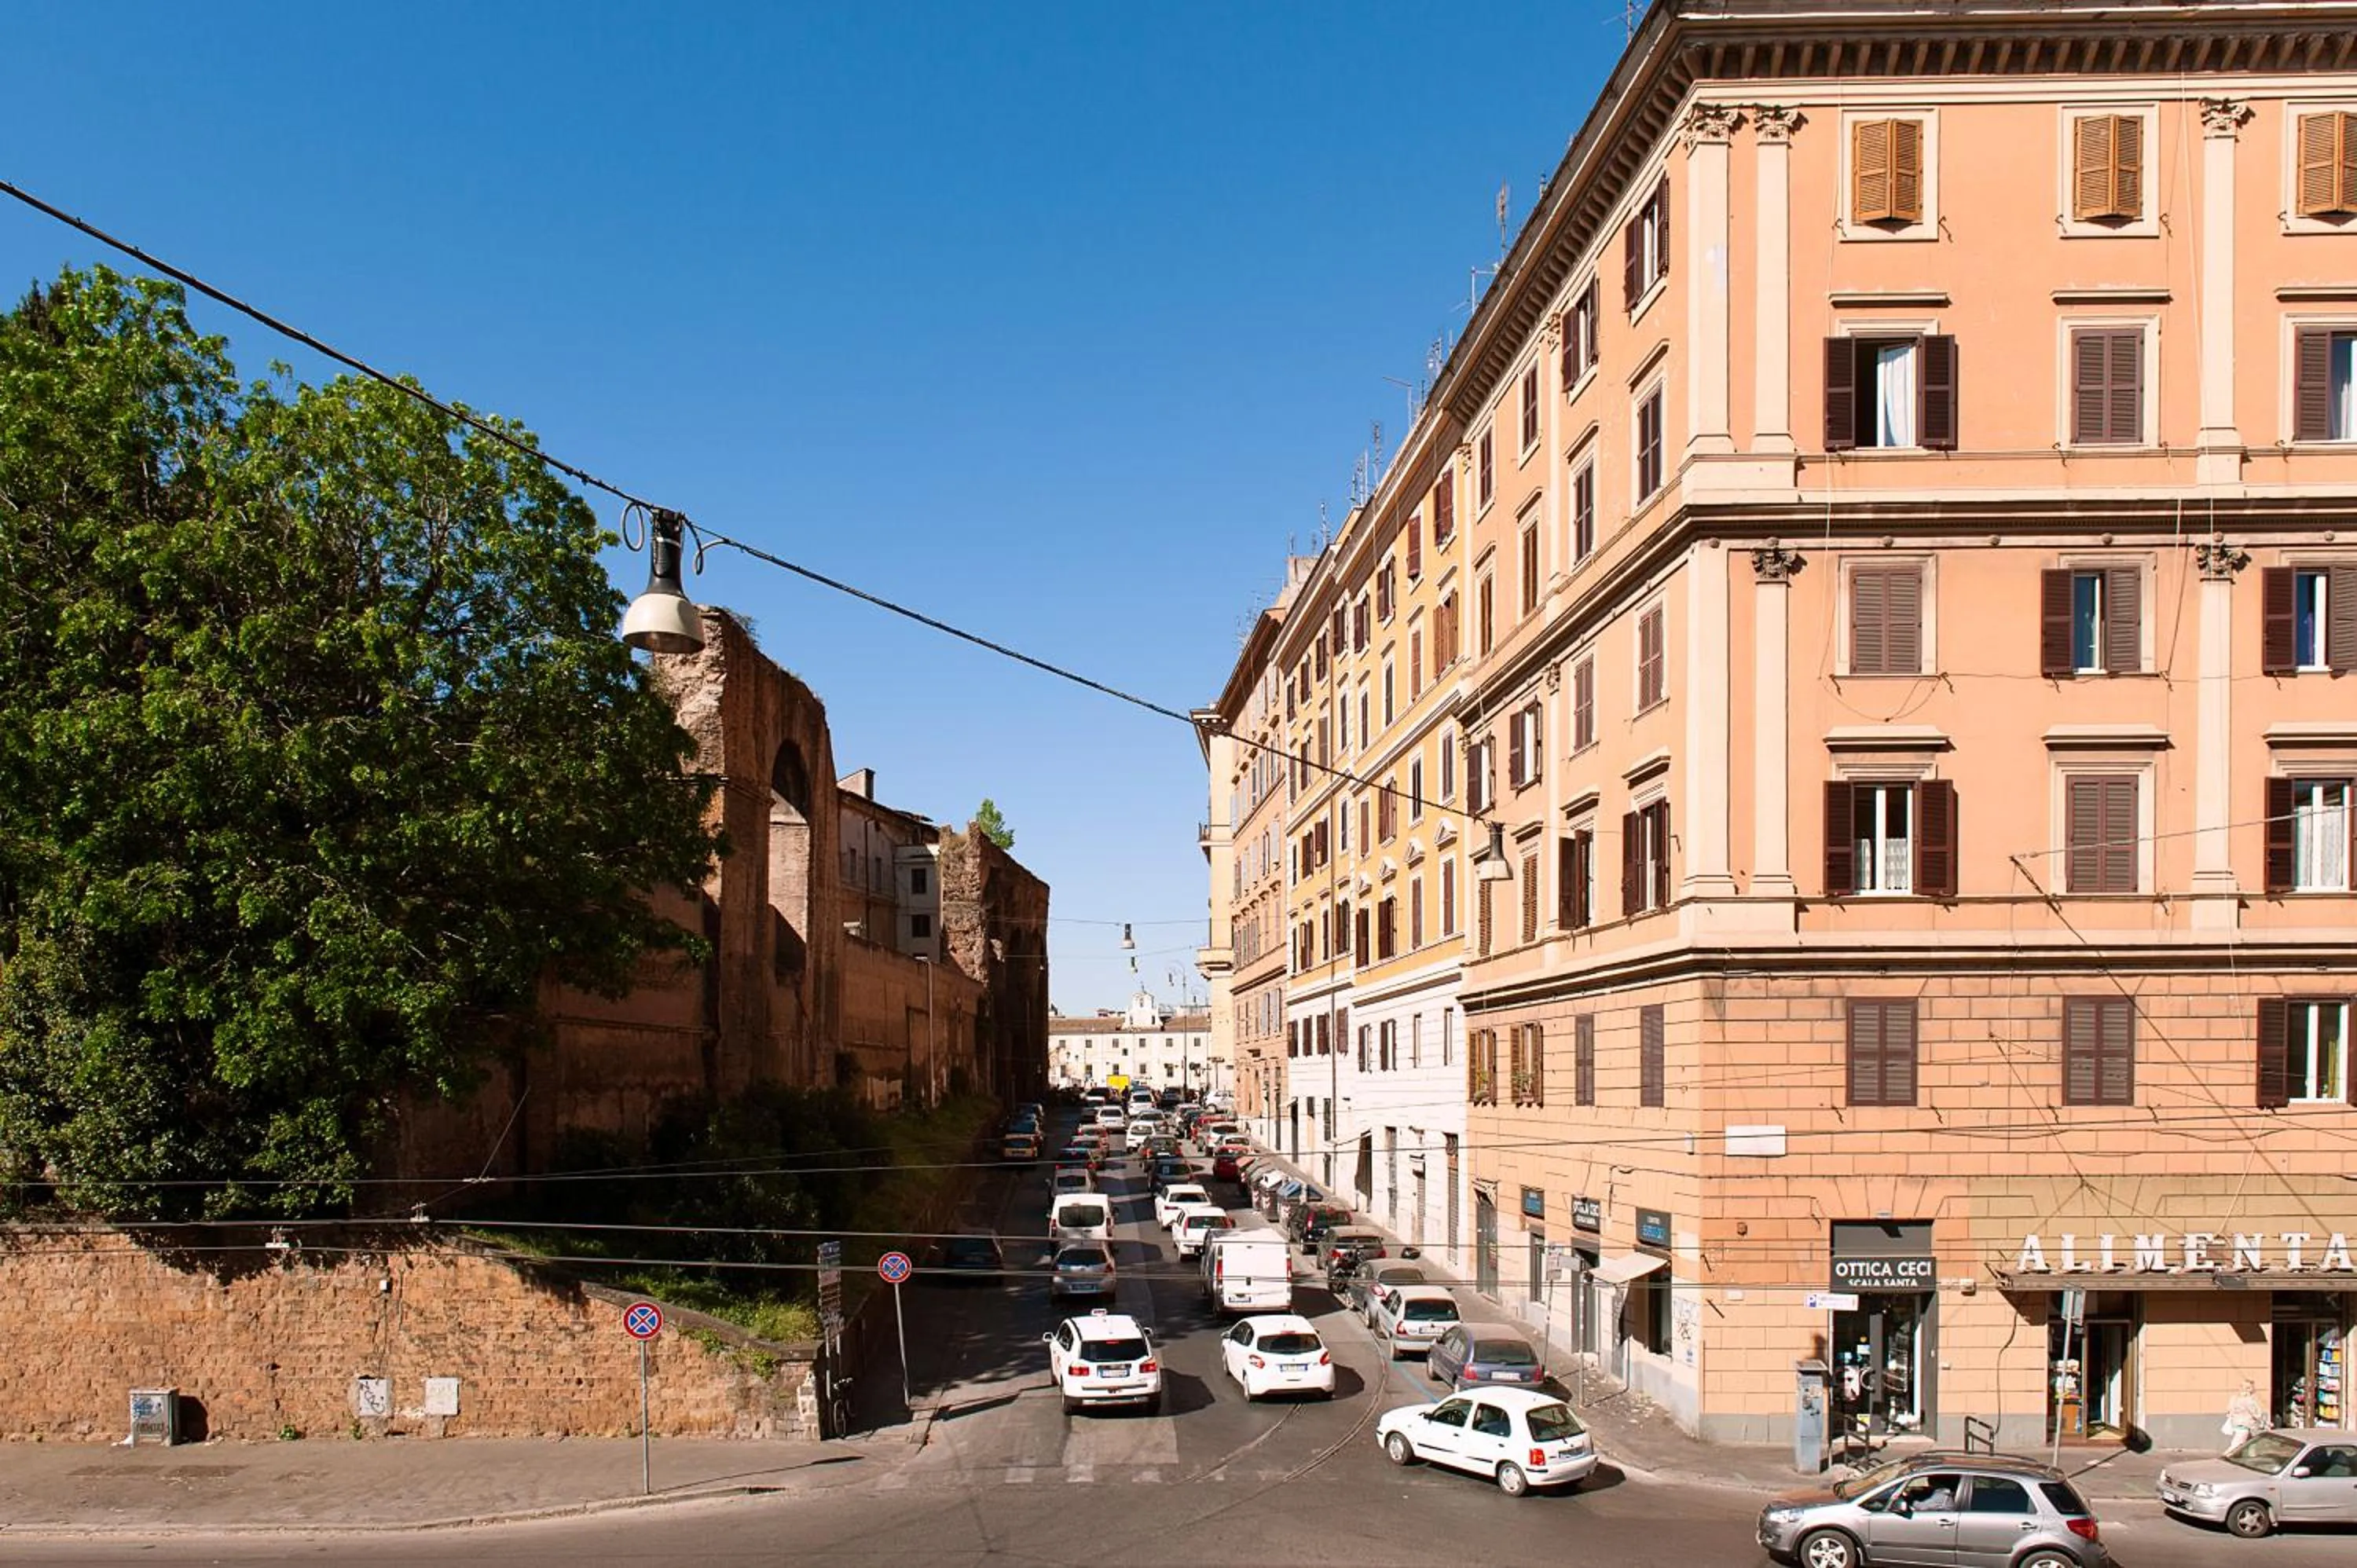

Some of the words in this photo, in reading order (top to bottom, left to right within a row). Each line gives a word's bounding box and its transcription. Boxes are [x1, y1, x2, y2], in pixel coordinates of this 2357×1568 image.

[1835, 1262, 1893, 1277] OTTICA
[1897, 1261, 1931, 1277] CECI
[1883, 1278, 1919, 1287] SANTA
